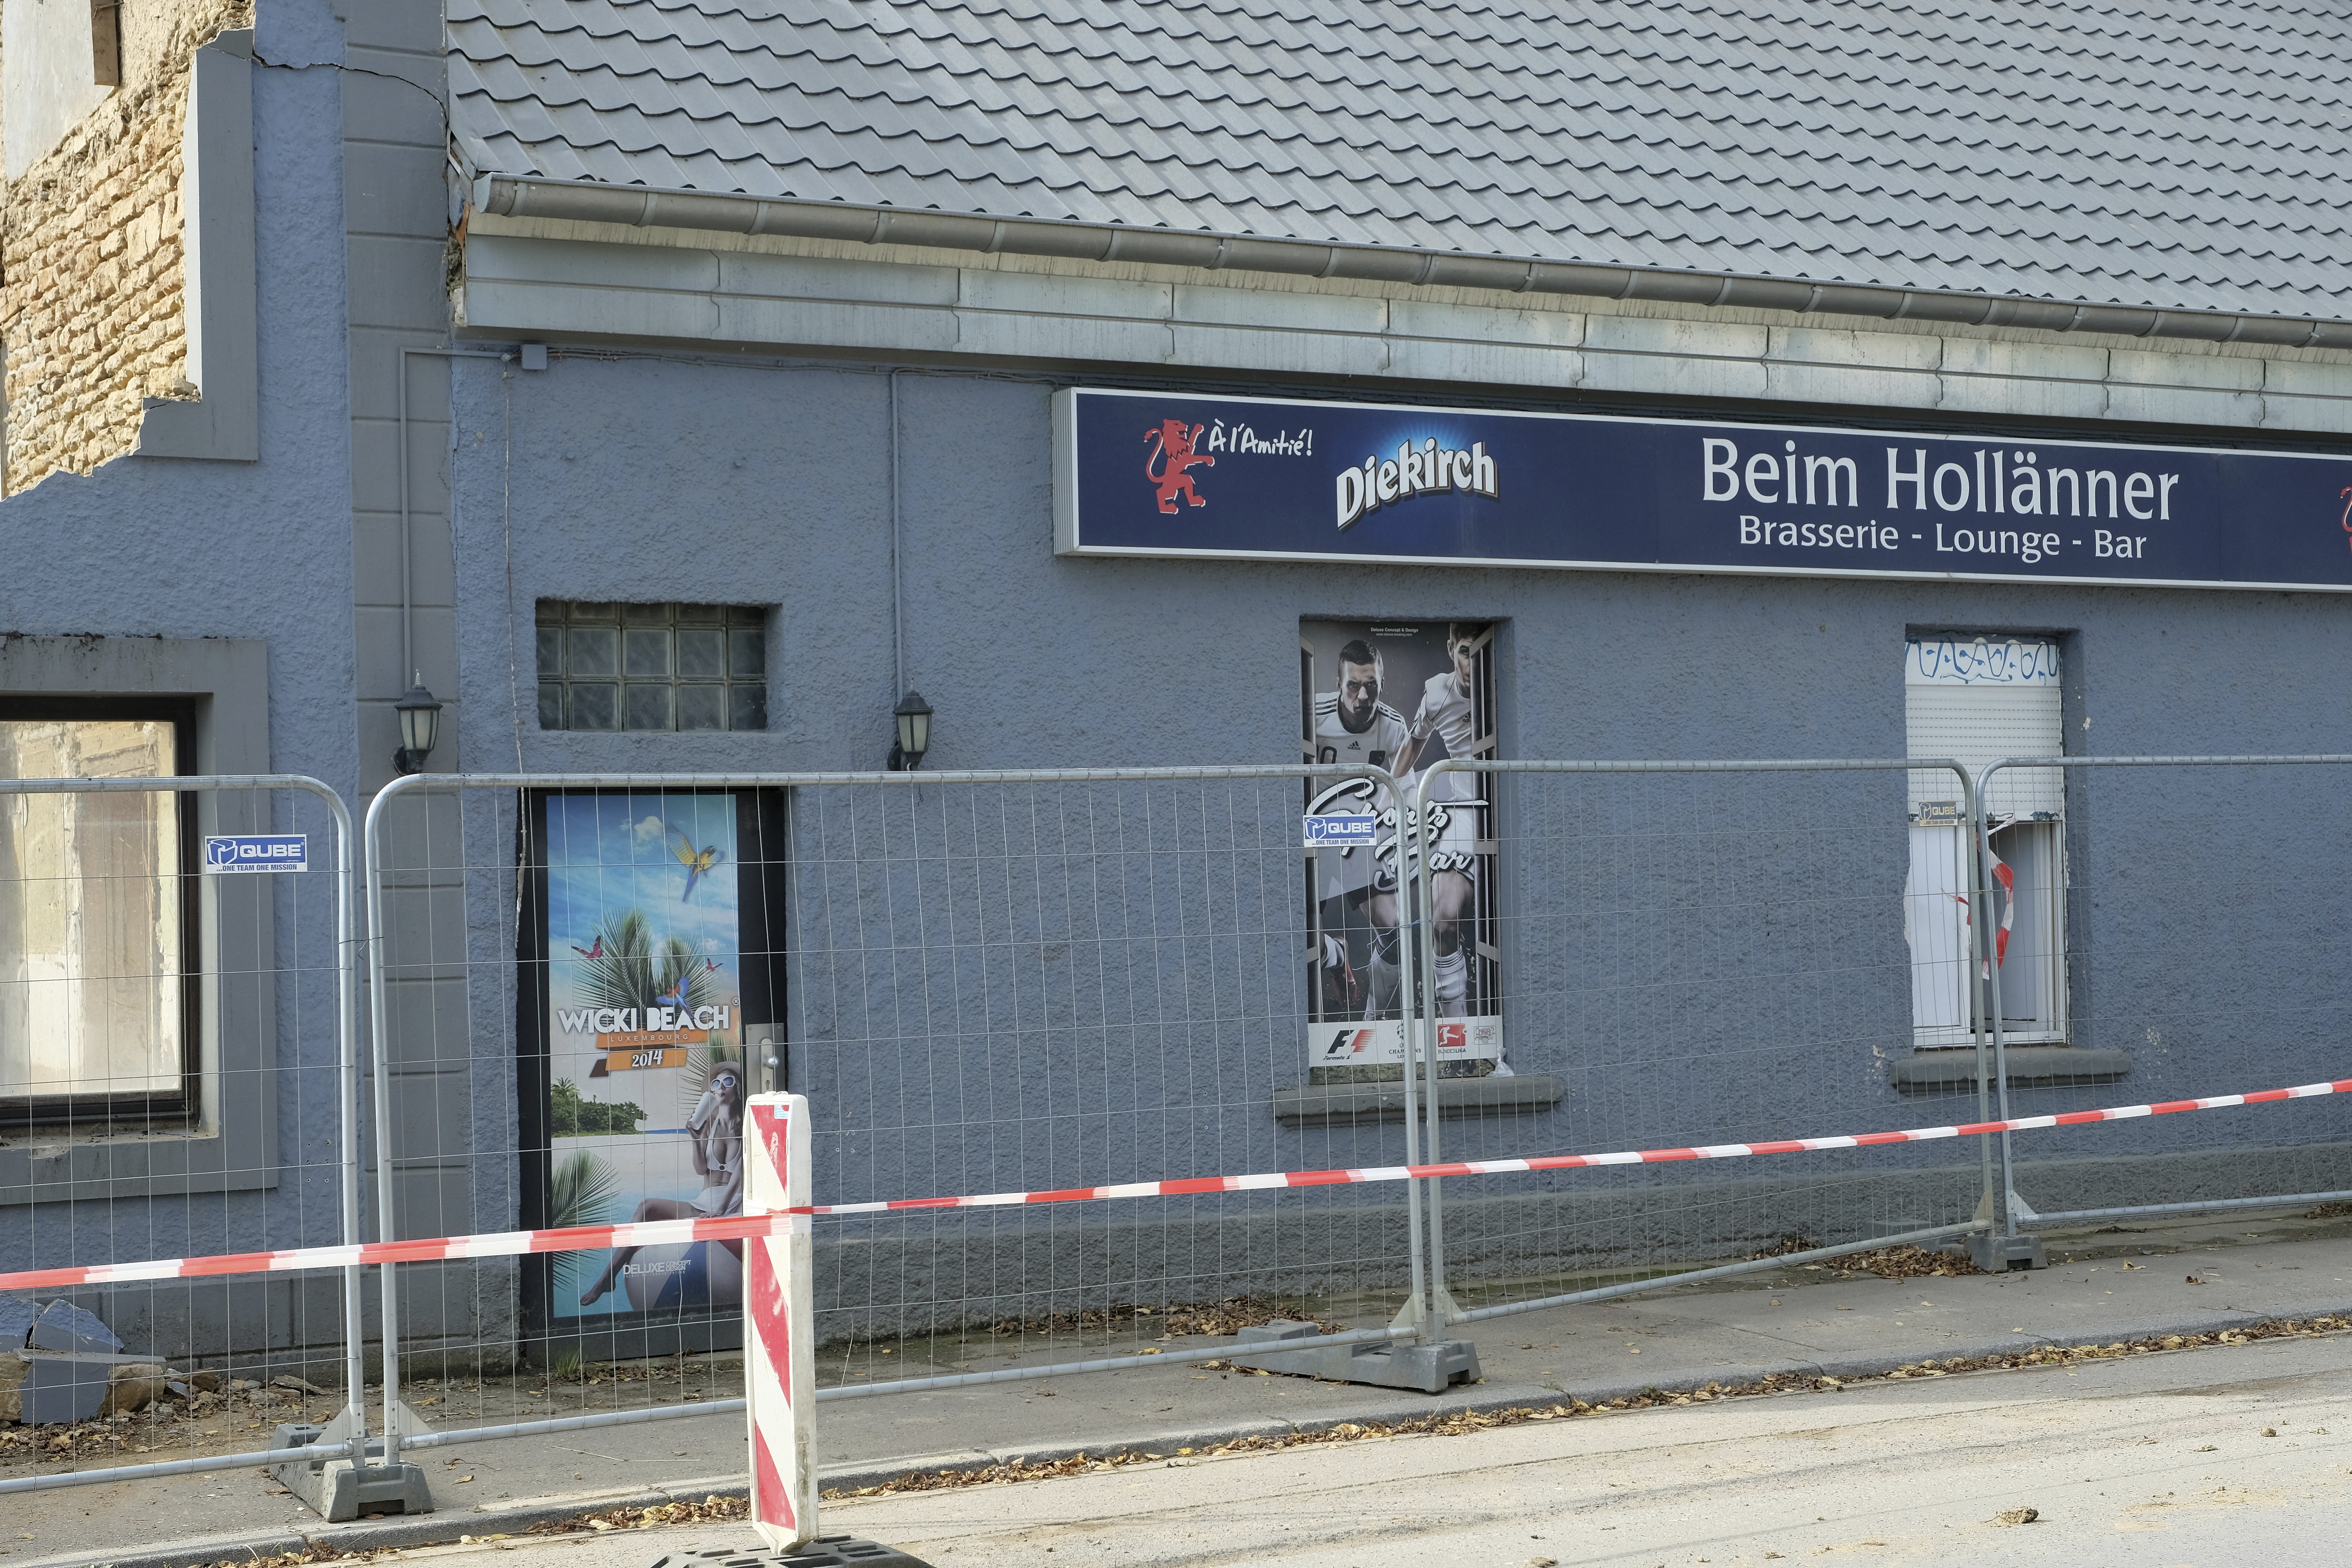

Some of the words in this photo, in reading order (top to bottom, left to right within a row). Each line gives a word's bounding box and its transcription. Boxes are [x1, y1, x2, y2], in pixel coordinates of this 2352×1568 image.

[1209, 418, 1226, 452] À
[1336, 437, 1496, 529] Diekirch
[1702, 437, 1858, 507] Beim
[1887, 447, 2179, 520] Hollänner
[1740, 515, 1898, 550] Brasserie
[1936, 523, 2060, 563] Lounge
[2094, 529, 2147, 559] Bar
[1932, 806, 1955, 815] QUBE
[1328, 822, 1372, 834] QUBE
[240, 844, 301, 858] QUBE
[558, 1007, 637, 1034] WICKI
[646, 1005, 729, 1032] BEACH
[610, 1034, 689, 1042] LUXEMBOURG
[632, 1050, 663, 1067] 2014
[623, 1262, 665, 1275] DELUXE
